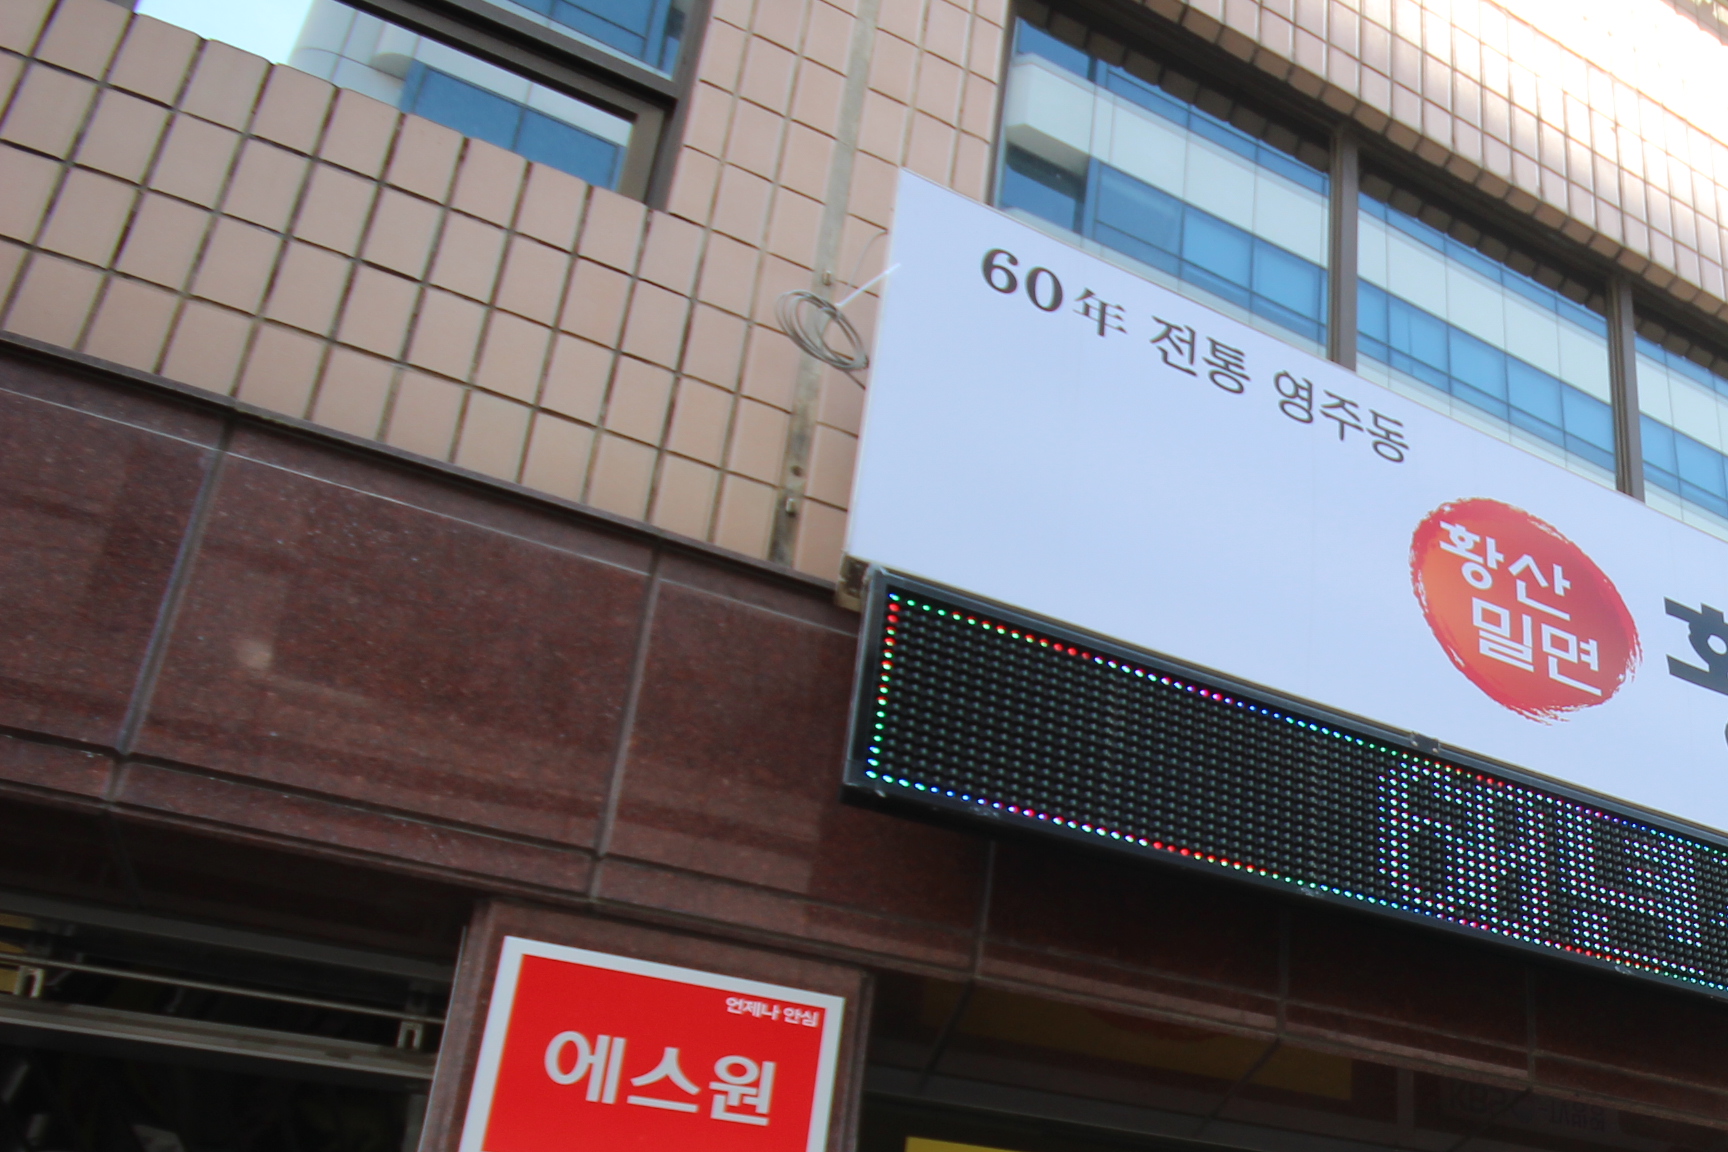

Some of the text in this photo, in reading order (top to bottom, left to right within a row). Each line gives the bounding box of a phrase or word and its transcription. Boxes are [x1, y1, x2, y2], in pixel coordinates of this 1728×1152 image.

[980, 247, 1410, 465] 60年 전통 영주동
[1438, 519, 1572, 621] 황산
[1471, 596, 1603, 698] 밀면
[726, 996, 820, 1028] 언제나 안심
[543, 1030, 777, 1127] 에스원
